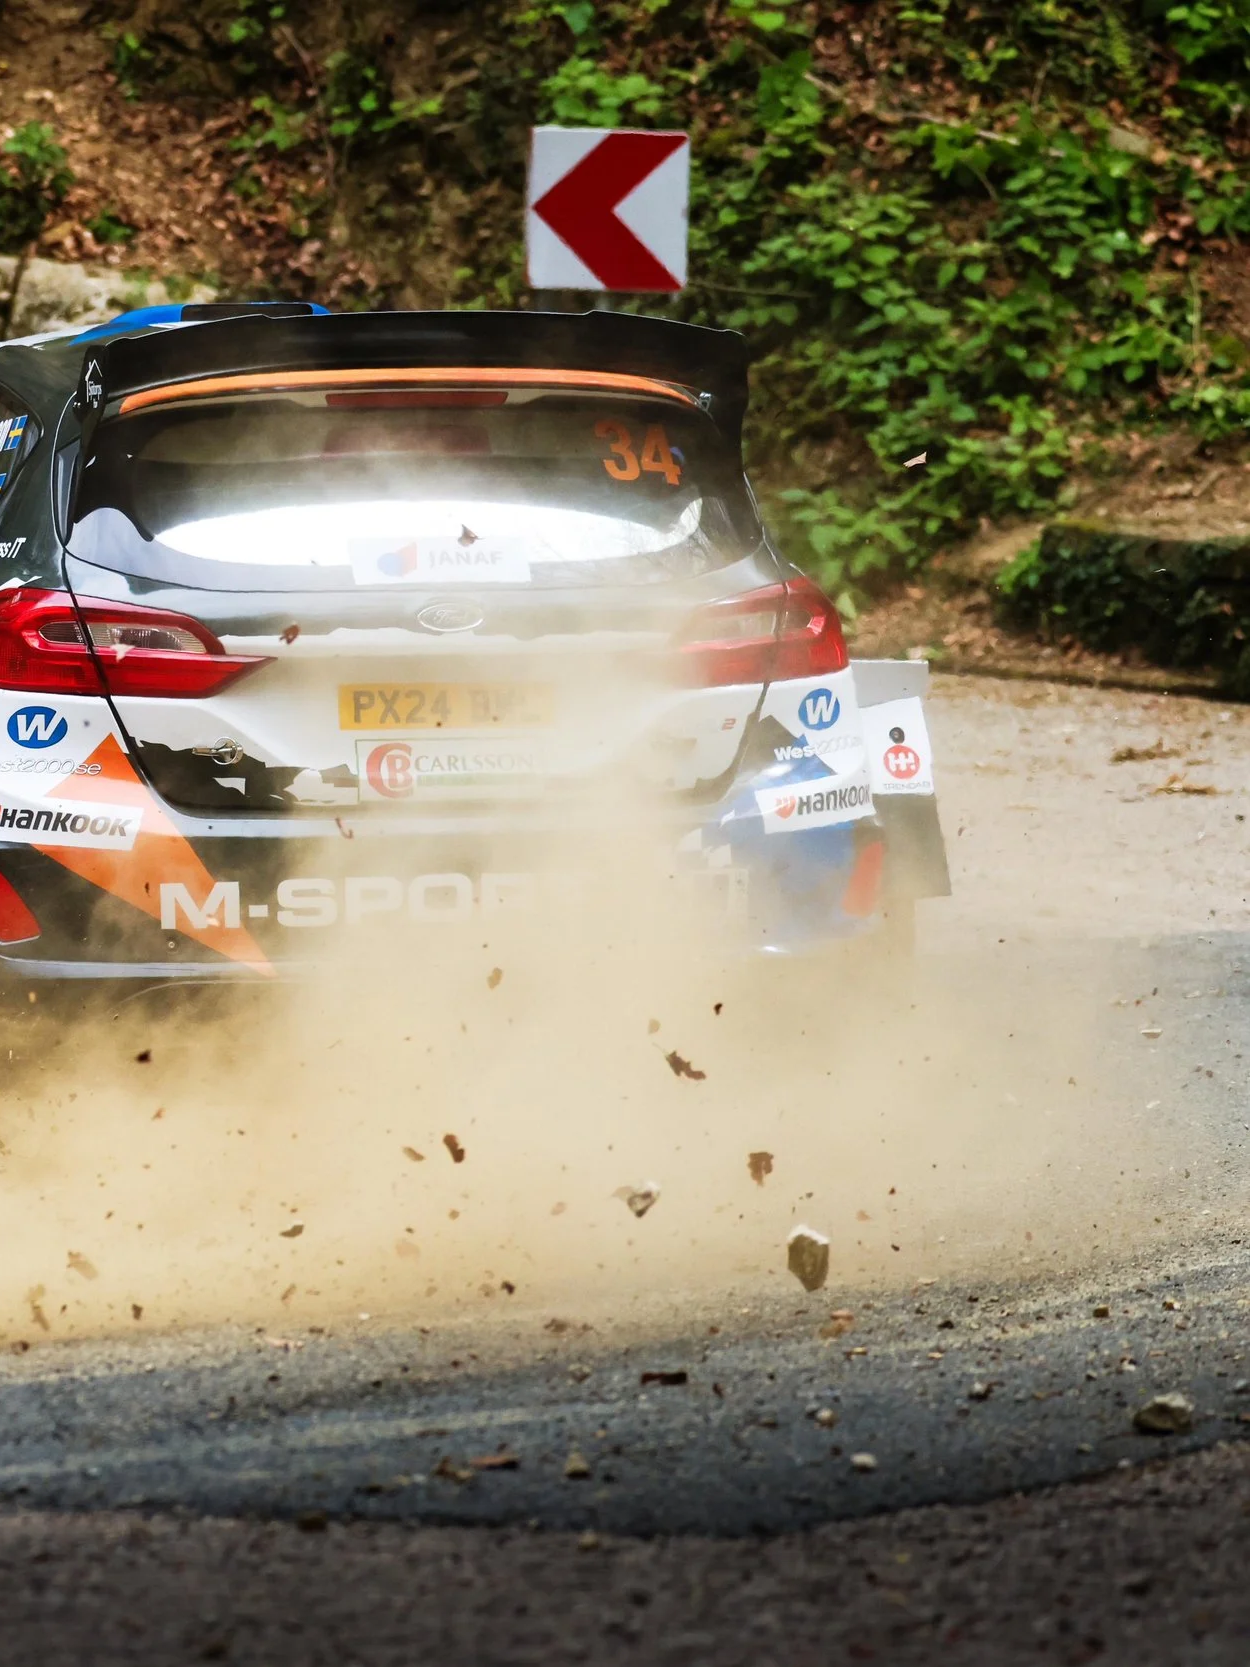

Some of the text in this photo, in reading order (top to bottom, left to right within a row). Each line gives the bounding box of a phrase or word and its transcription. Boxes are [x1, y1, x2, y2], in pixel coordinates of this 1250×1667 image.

[595, 419, 682, 486] 34
[7, 537, 27, 559] IT
[429, 551, 504, 567] JANAF
[352, 688, 452, 725] PX24
[414, 753, 534, 773] CARLSSON
